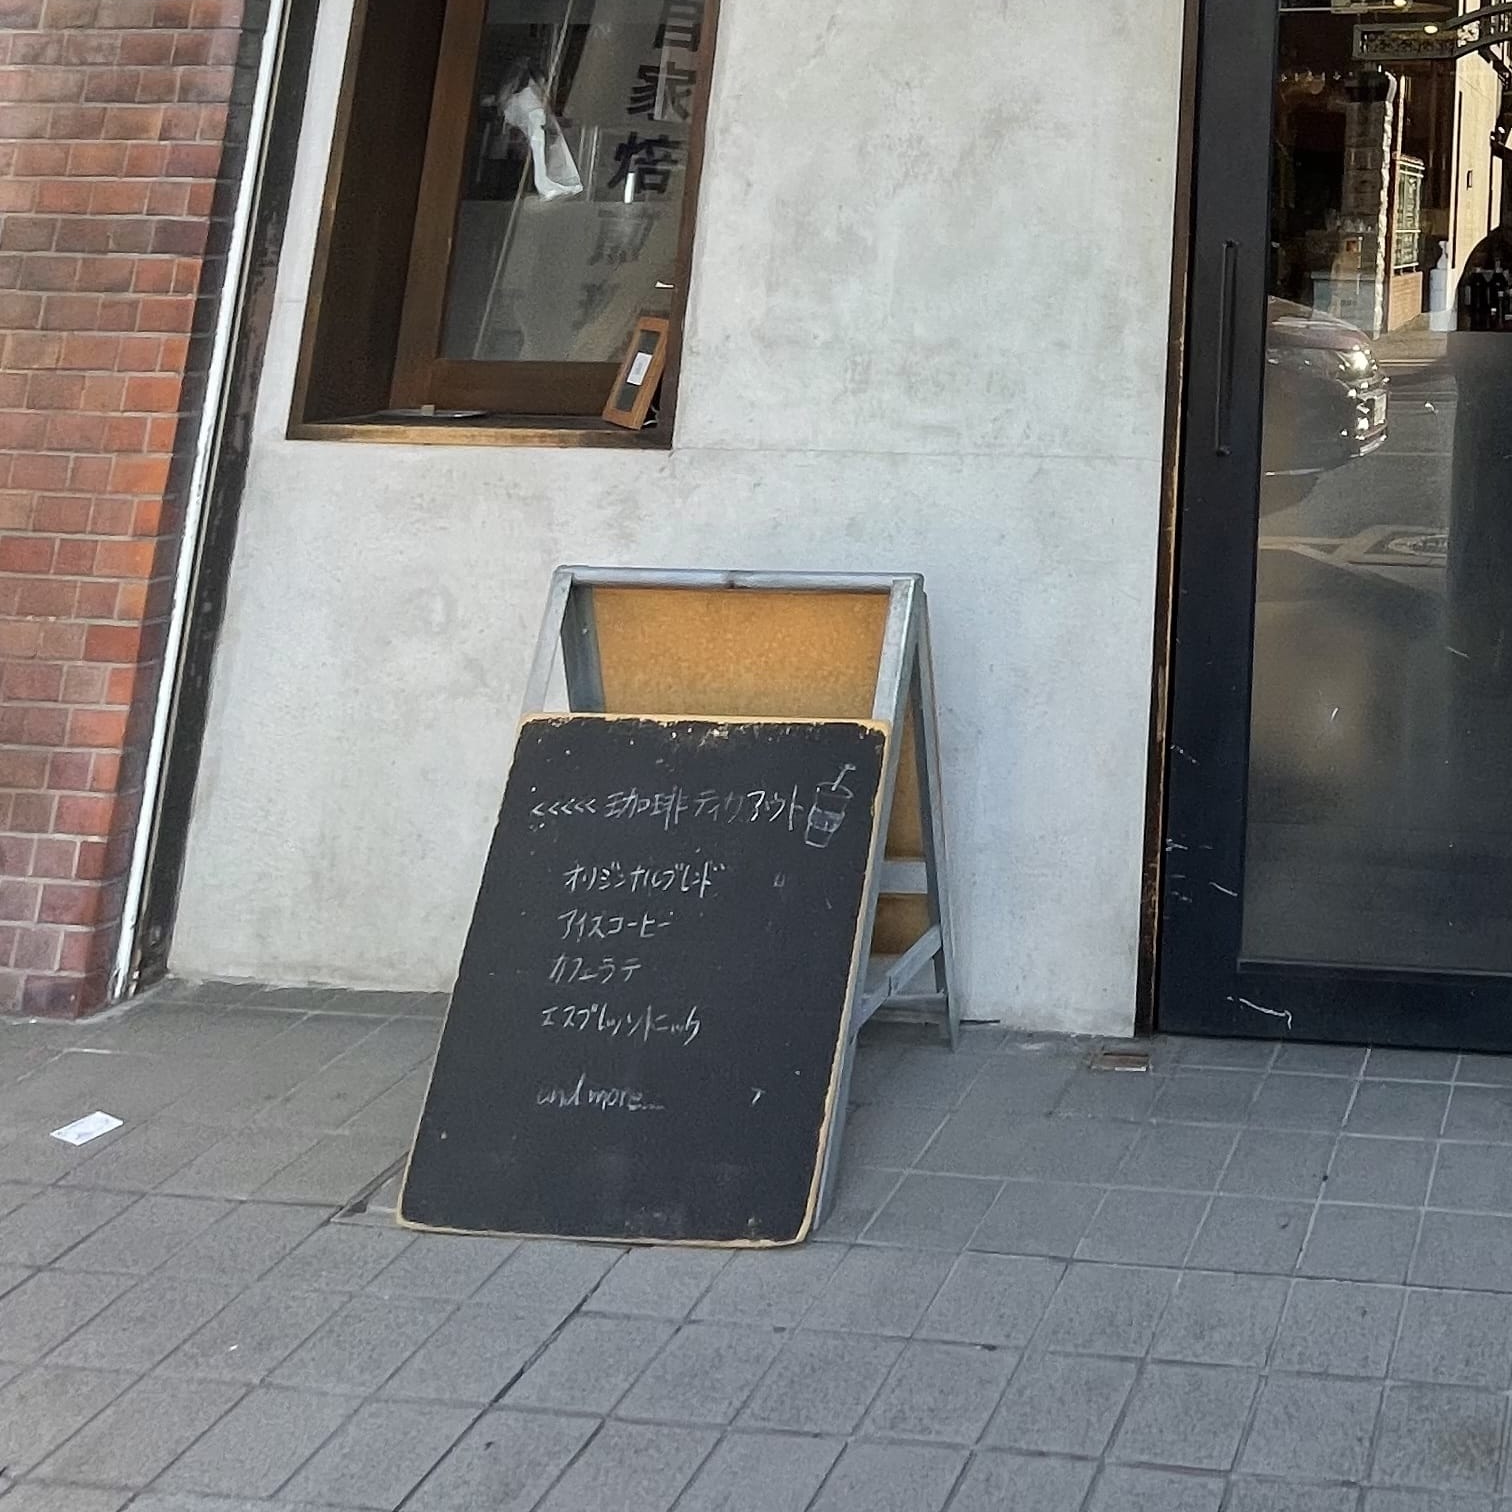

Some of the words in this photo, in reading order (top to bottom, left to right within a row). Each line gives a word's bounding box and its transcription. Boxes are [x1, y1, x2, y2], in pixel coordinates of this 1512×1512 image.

[557, 908, 673, 942] アイスコーヒー
[548, 952, 642, 984] カフェラテ
